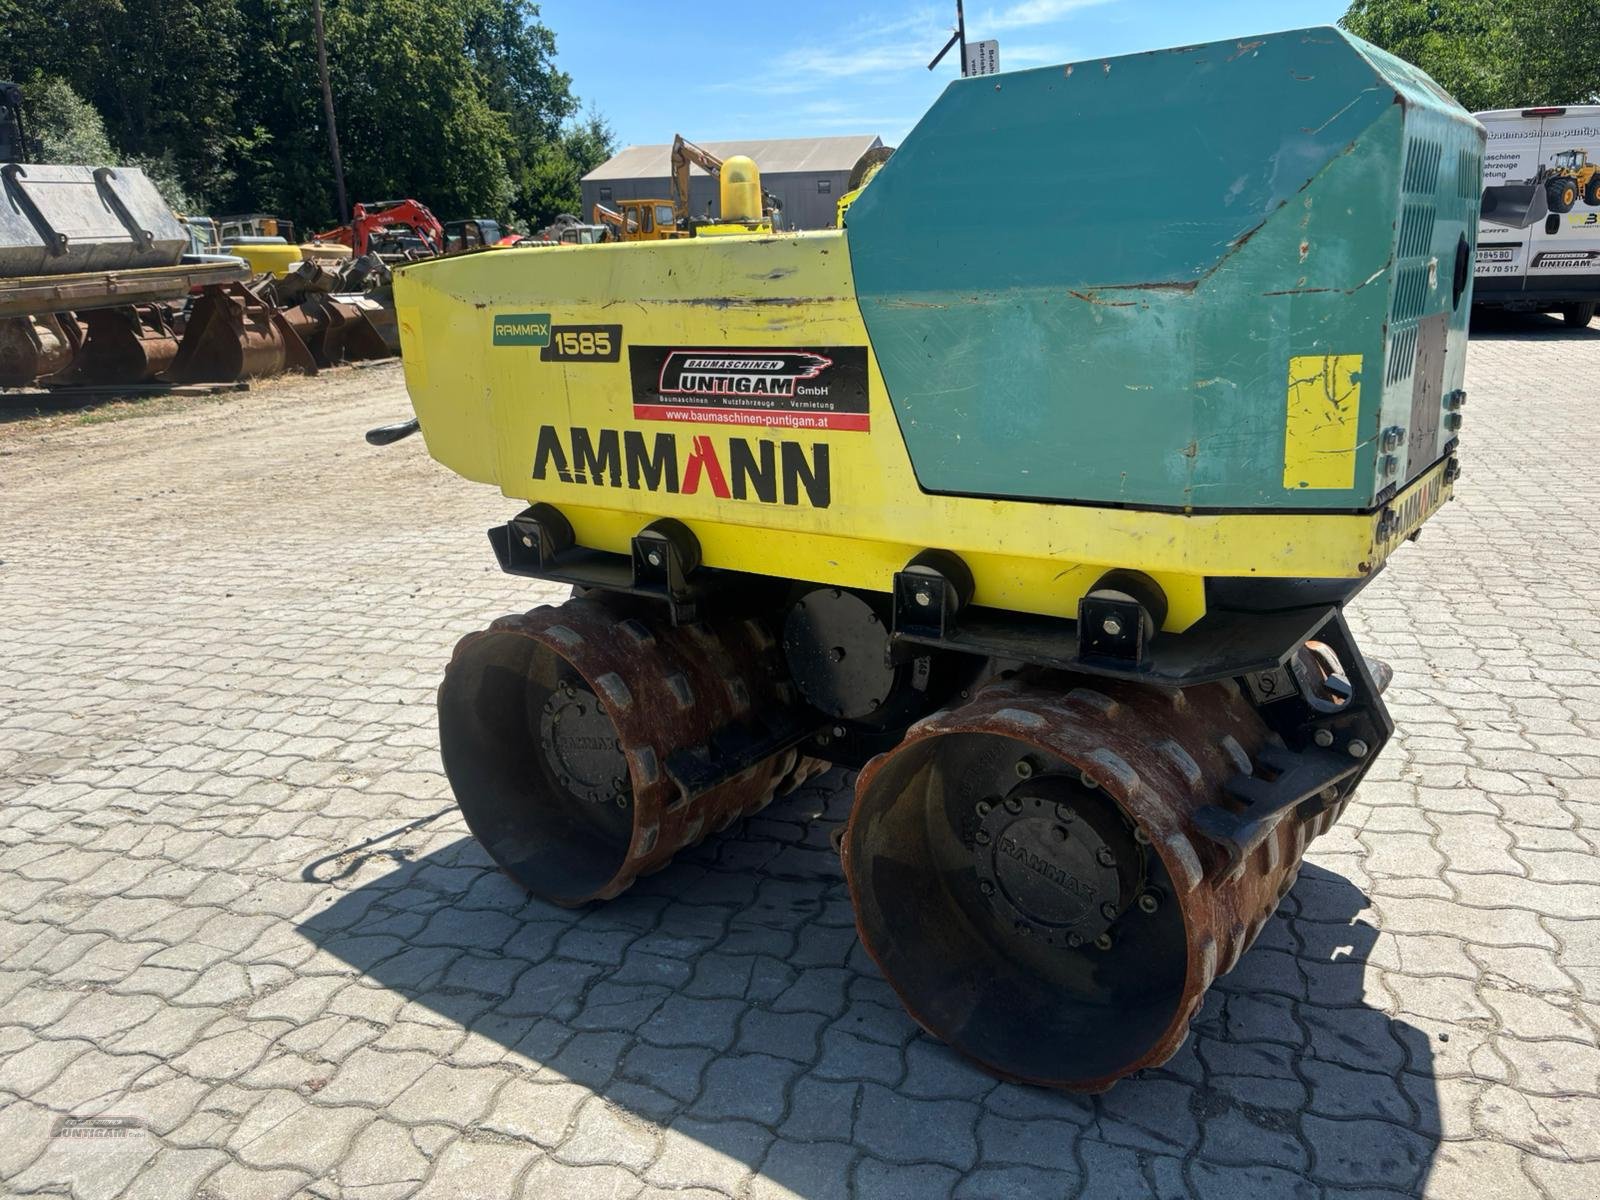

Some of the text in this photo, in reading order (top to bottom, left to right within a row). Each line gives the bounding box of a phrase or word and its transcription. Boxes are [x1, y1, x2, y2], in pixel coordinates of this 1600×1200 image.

[495, 324, 549, 336] RAMMAX
[555, 332, 612, 355] 1585
[687, 360, 779, 370] BAUMASCHINEN
[797, 386, 829, 396] GmbH
[659, 396, 835, 410] Baumaschinen Nutzfahrzeuge Vermietung
[665, 409, 828, 428] www.baumaschinen-puntigam.at
[532, 425, 831, 509] AMMANN
[999, 838, 1097, 904] RAMMAX
